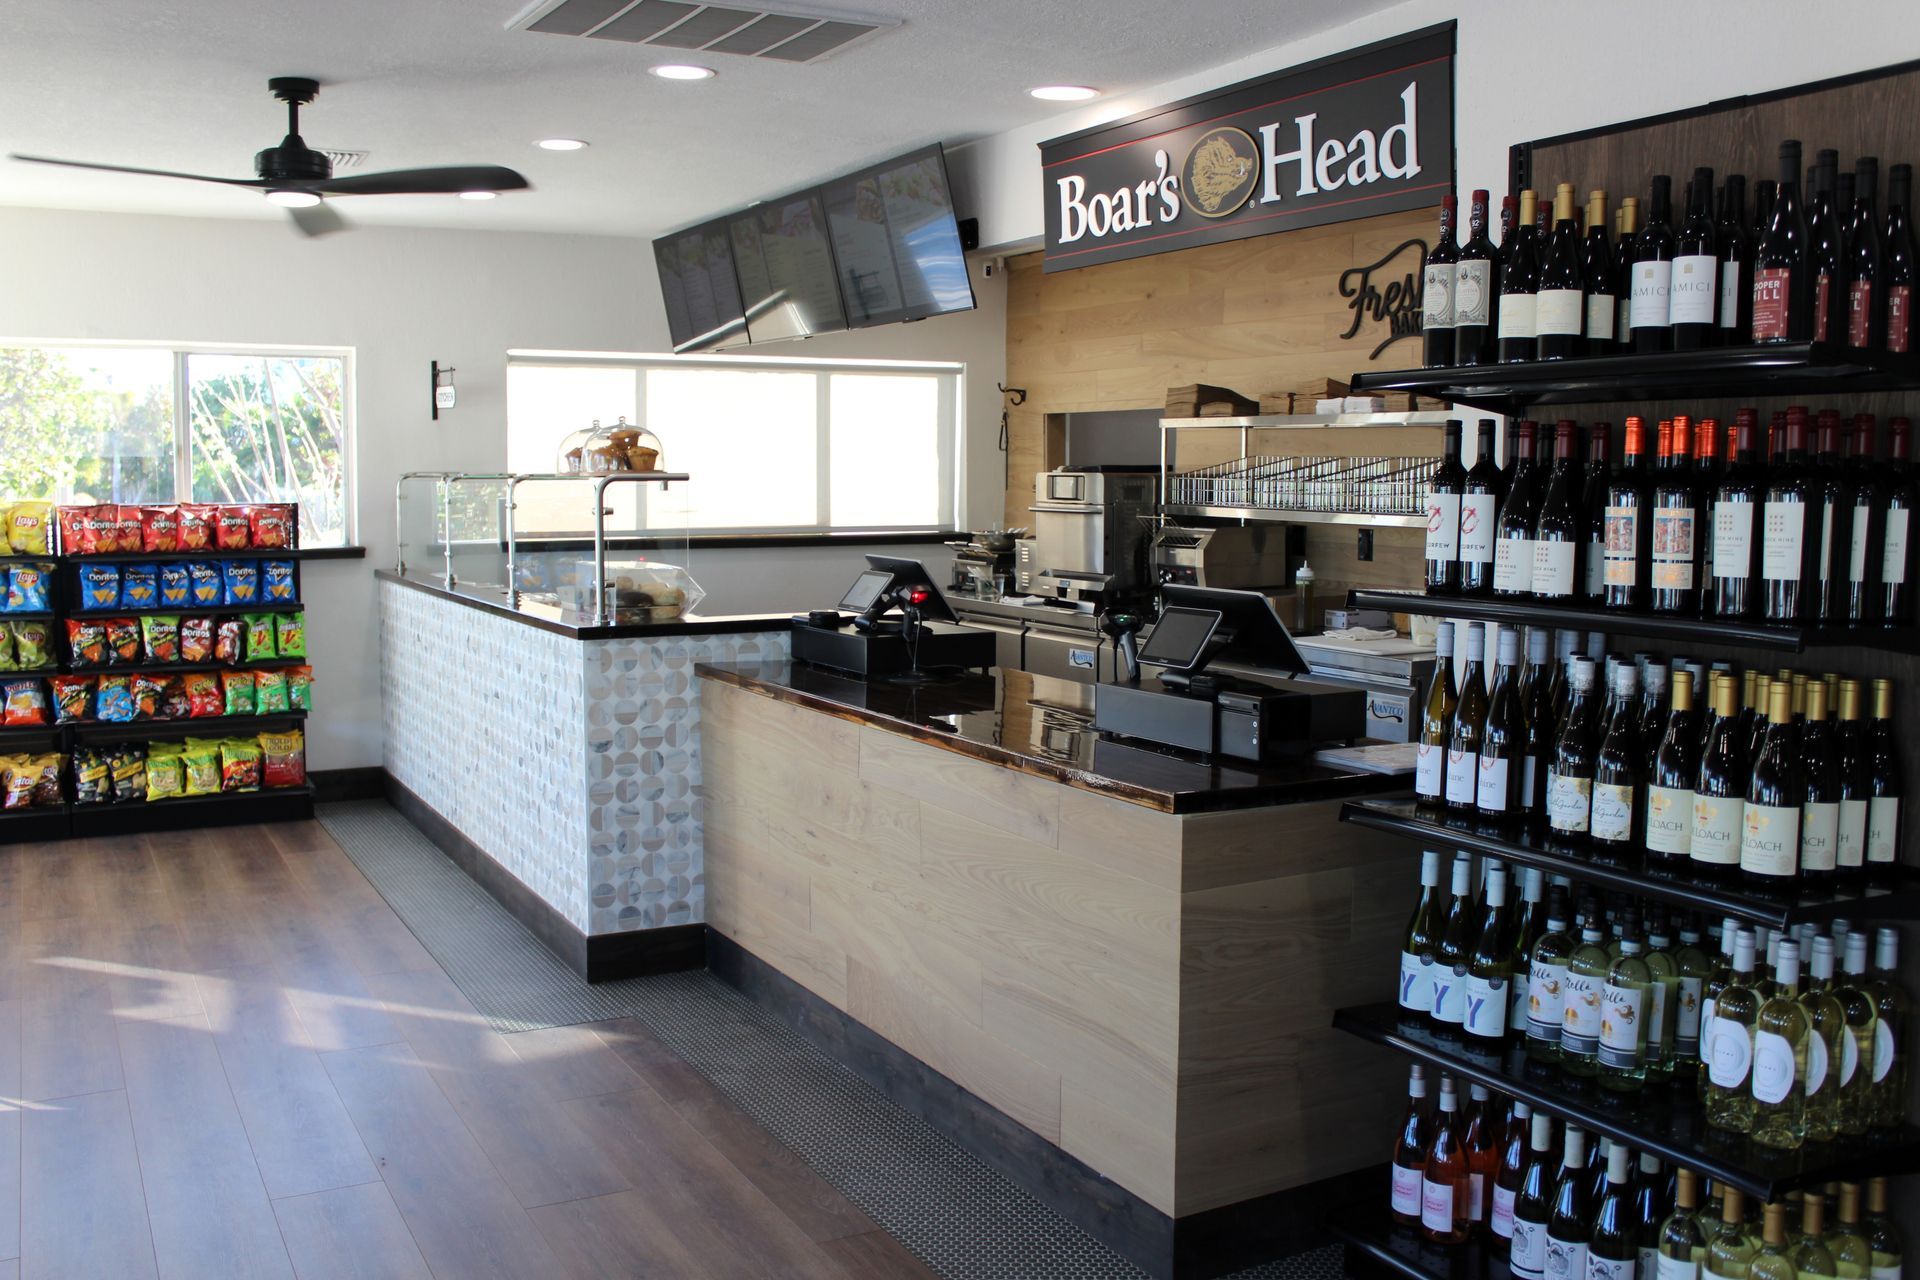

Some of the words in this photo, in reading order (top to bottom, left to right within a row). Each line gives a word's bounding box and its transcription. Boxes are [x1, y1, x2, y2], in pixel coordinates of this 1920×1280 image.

[1057, 149, 1181, 244] Boar's
[1259, 81, 1422, 205] Head
[1633, 287, 1670, 297] AMICI
[1673, 282, 1711, 293] AMICI
[1367, 701, 1404, 719] AVANTCO
